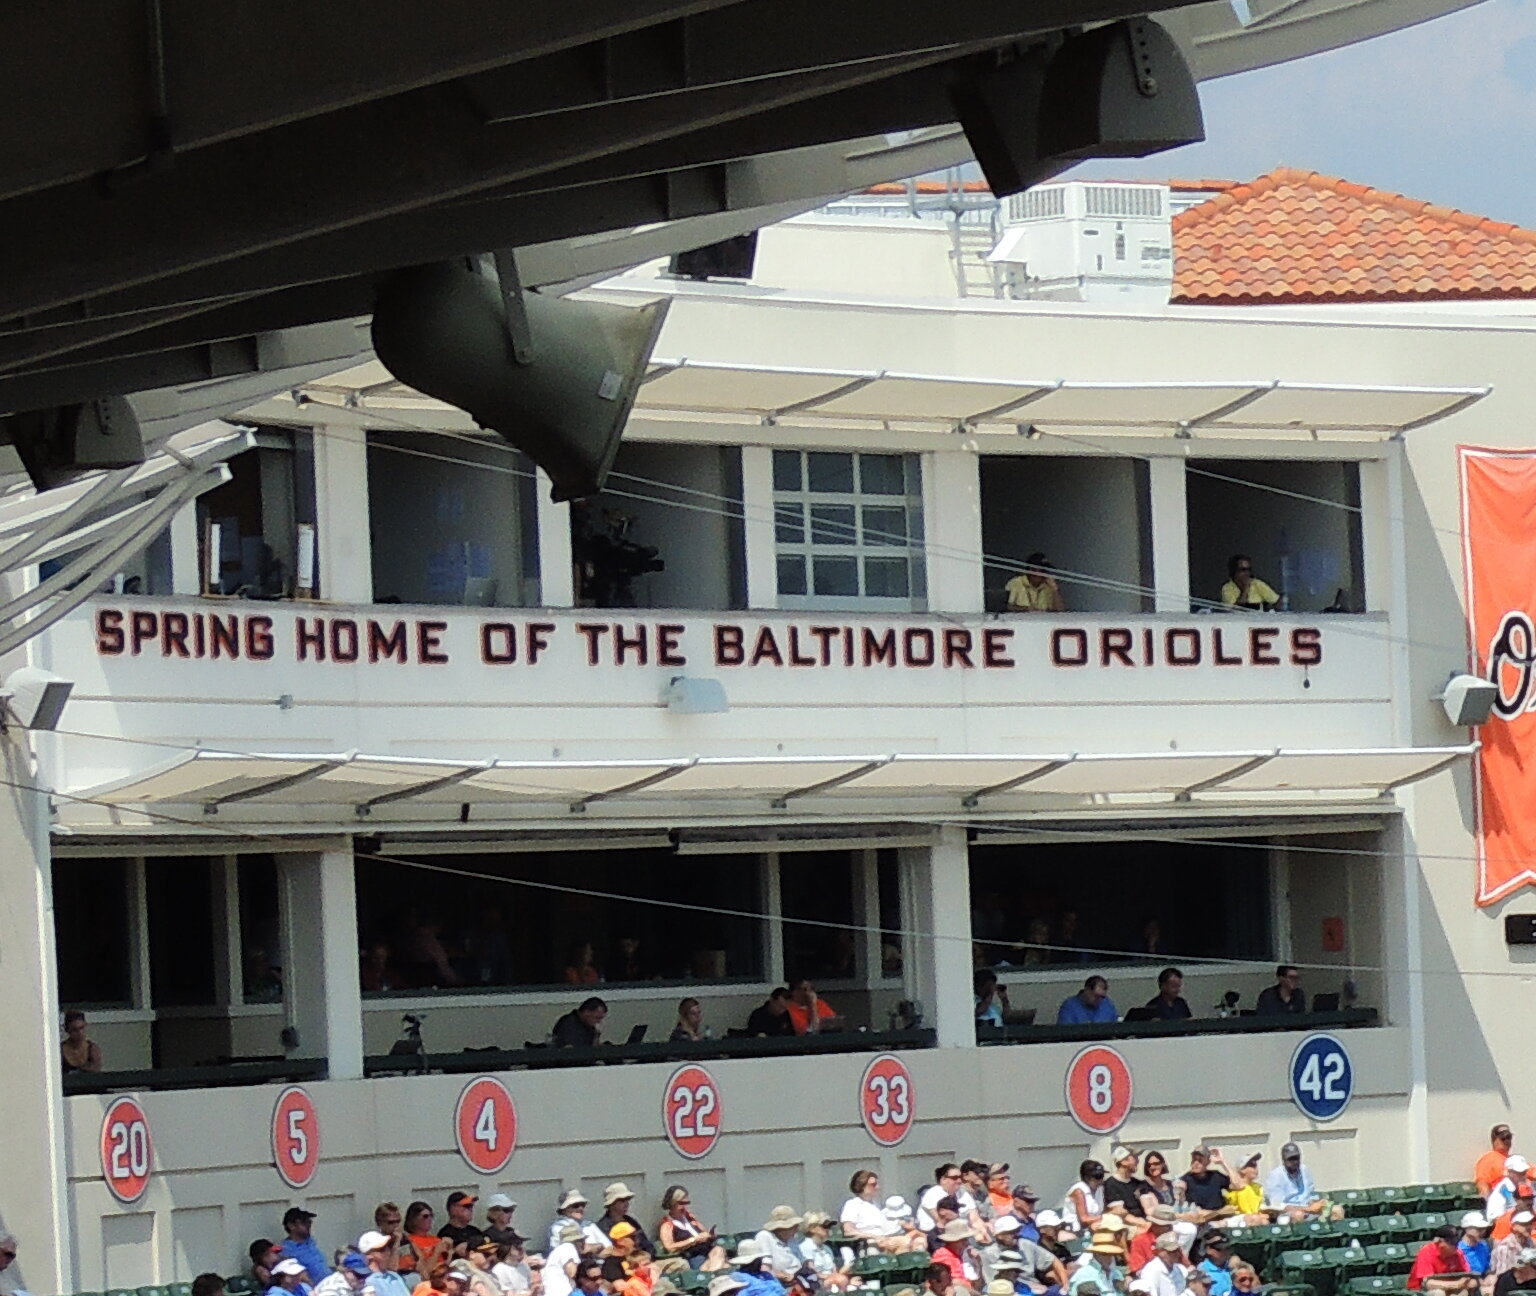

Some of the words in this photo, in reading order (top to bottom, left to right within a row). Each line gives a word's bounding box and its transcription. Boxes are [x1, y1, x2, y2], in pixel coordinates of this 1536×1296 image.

[96, 609, 275, 660] SPRING
[295, 616, 449, 665] HOME
[479, 622, 556, 666] OF
[575, 622, 687, 667] THE
[713, 624, 1016, 668] BALTIMORE
[1050, 626, 1323, 667] ORIOLES
[868, 1075, 909, 1125] 33
[1087, 1064, 1112, 1113] 8
[1299, 1052, 1347, 1100] 42
[288, 1110, 308, 1164] 5
[475, 1098, 498, 1151] 4
[673, 1085, 717, 1137] 22
[110, 1121, 149, 1178] 20
